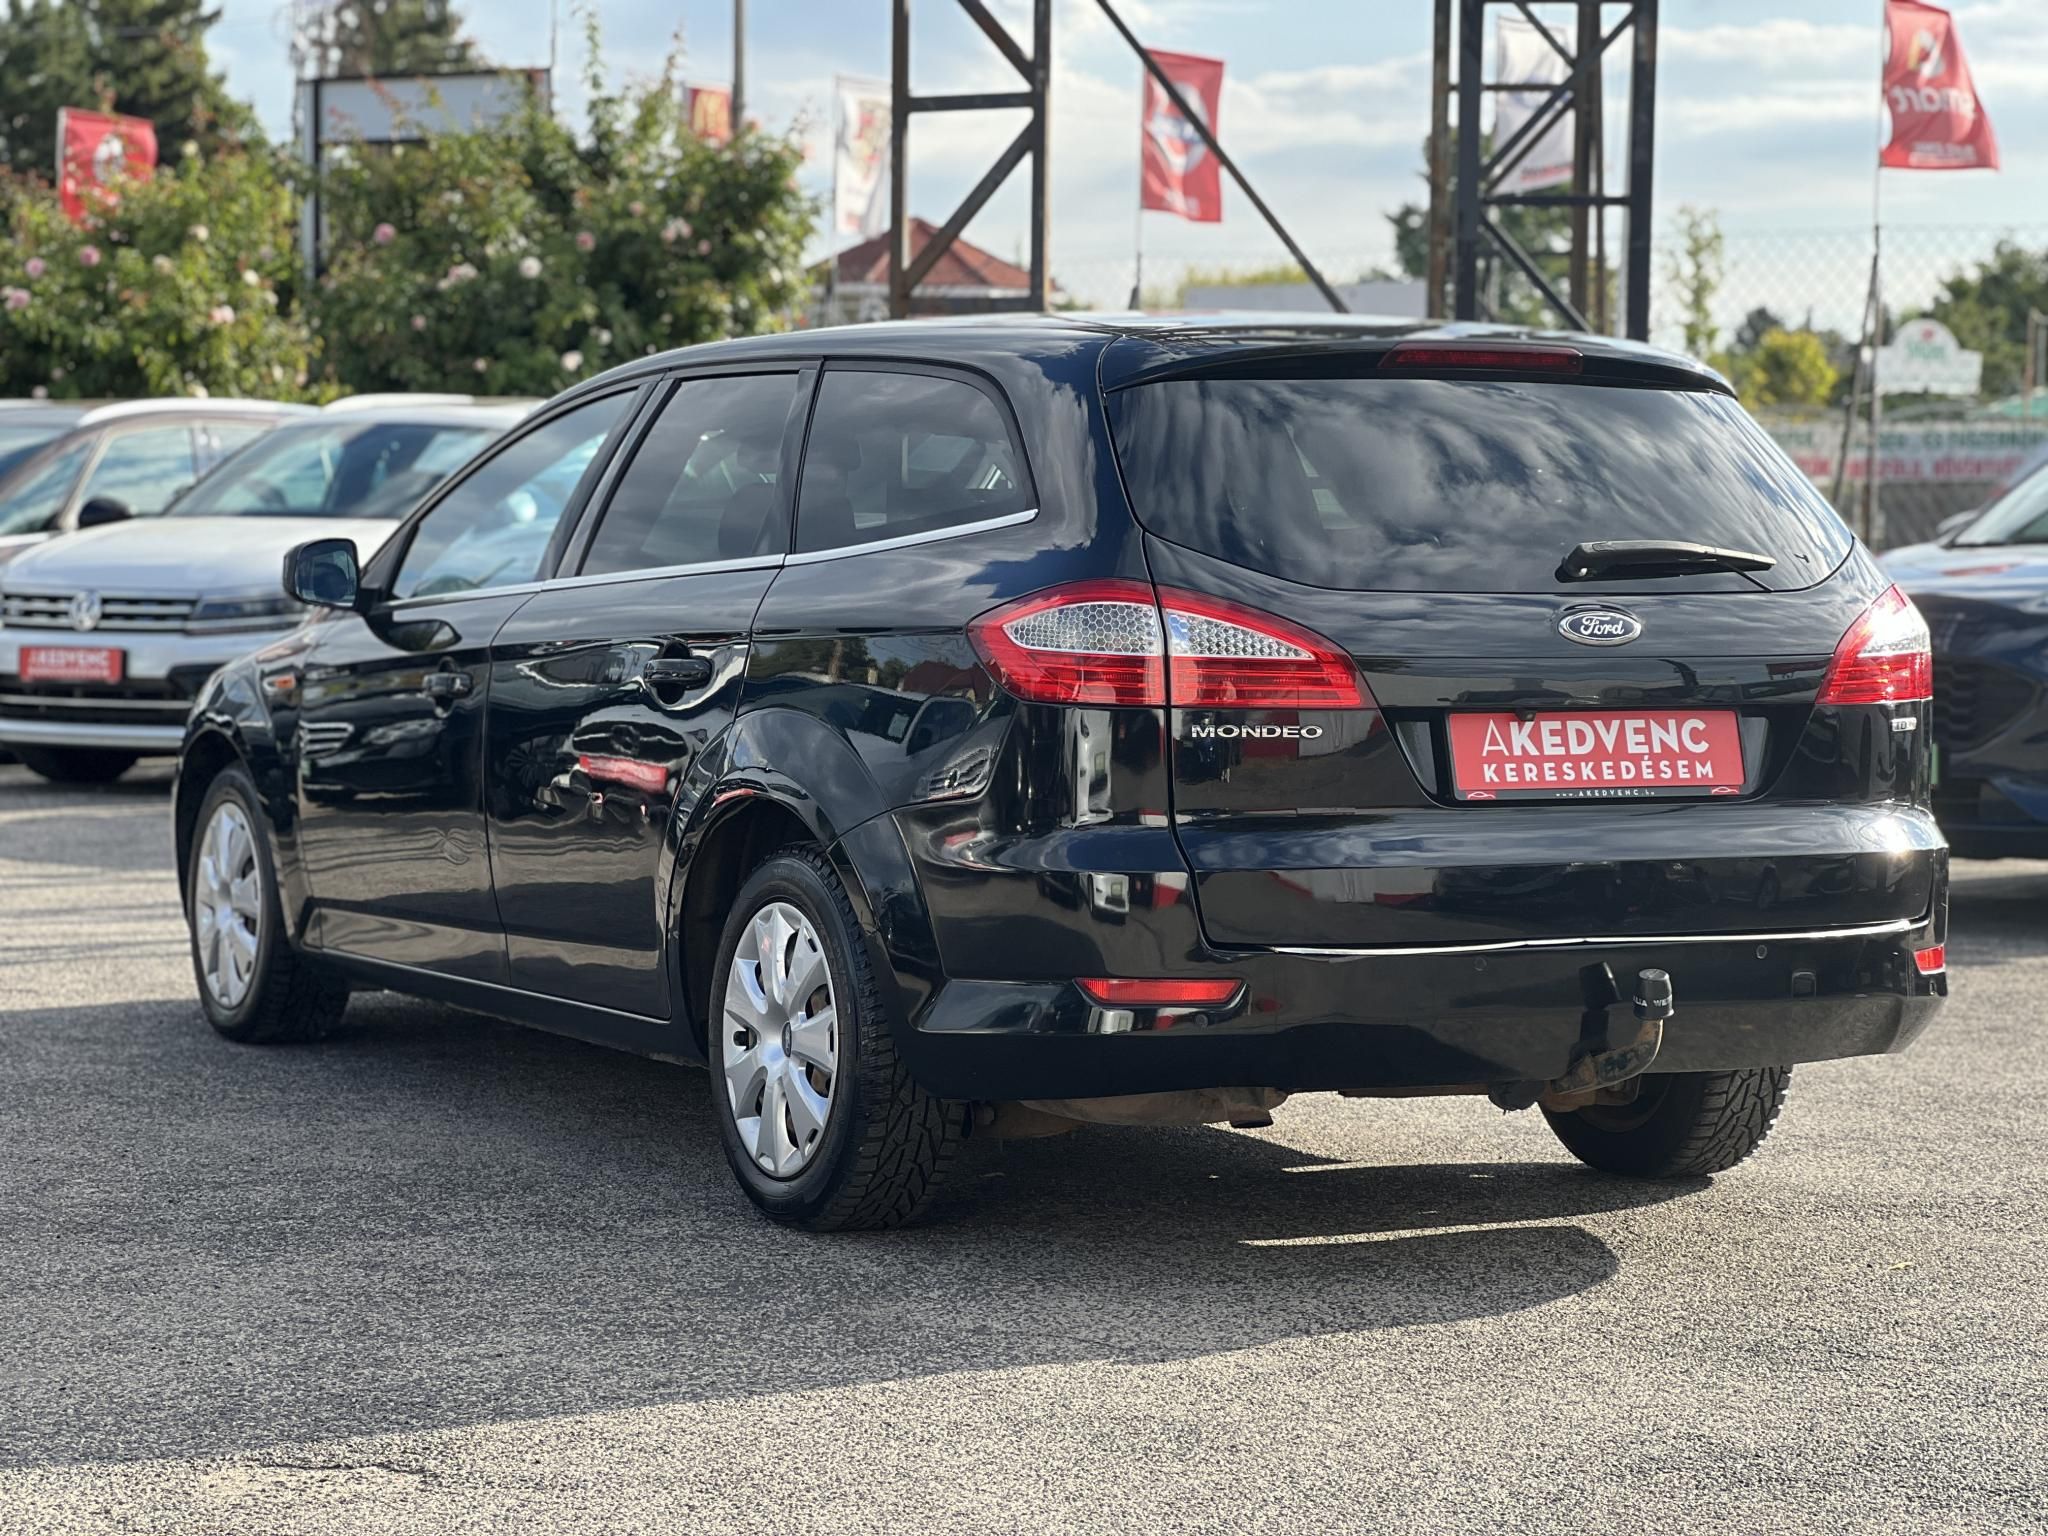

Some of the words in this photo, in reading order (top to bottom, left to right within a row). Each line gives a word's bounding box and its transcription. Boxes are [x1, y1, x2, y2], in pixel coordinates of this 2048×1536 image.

[1580, 616, 1625, 636] Ford
[1191, 724, 1323, 739] MONDEO
[1482, 718, 1710, 757] AKEDVENC
[1483, 755, 1714, 783] KERESKEDÉSEM
